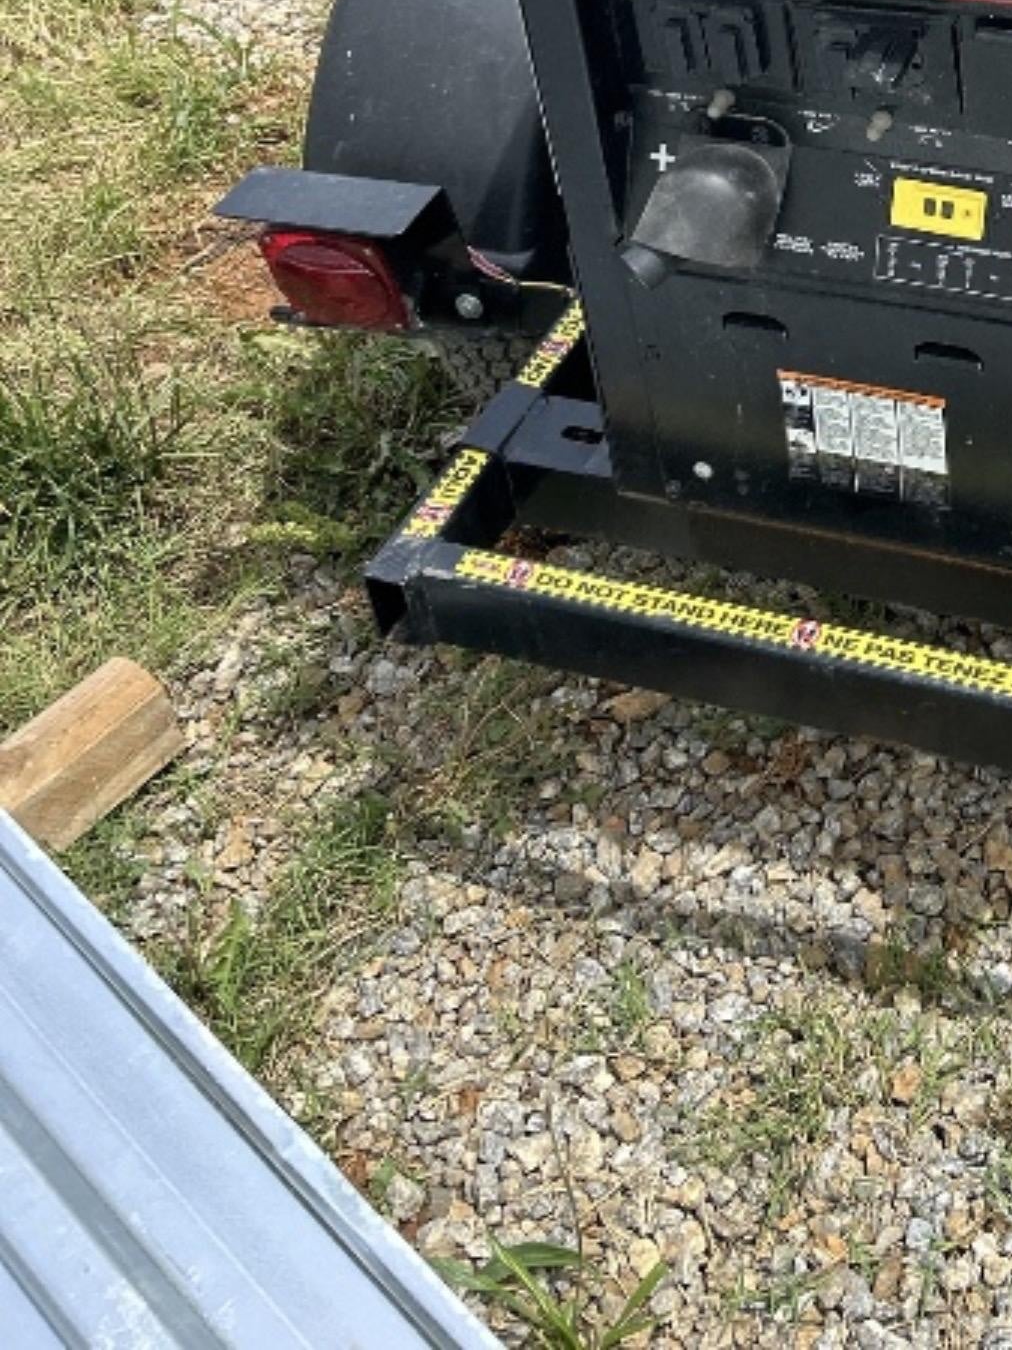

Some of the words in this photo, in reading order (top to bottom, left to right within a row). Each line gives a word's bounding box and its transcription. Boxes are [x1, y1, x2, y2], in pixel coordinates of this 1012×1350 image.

[536, 571, 574, 590] DO
[577, 580, 632, 601] NOT
[634, 593, 714, 619] STAND
[719, 609, 788, 638] HERE
[823, 633, 860, 652] NE
[865, 641, 917, 664] PAS
[923, 653, 1009, 684] TENEZ
